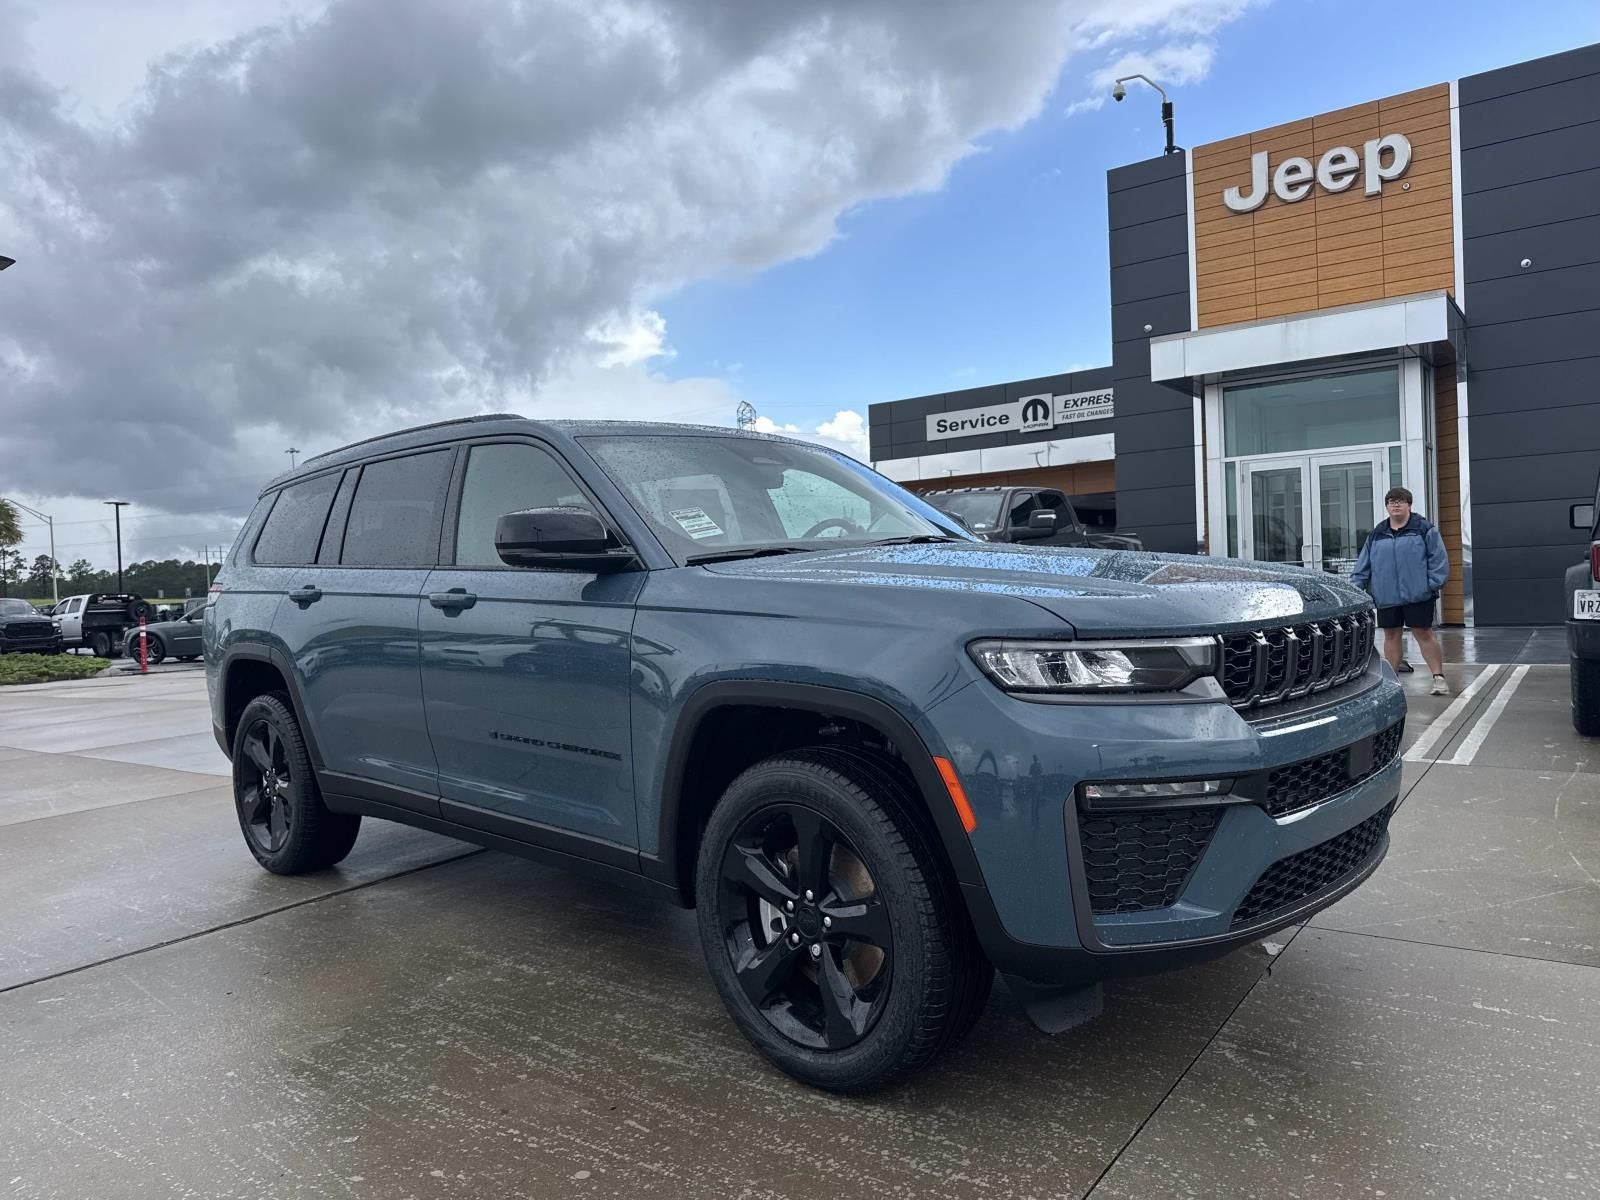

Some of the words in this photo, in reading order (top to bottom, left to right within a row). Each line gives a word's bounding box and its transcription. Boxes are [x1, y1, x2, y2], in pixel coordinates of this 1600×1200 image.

[1223, 133, 1412, 214] Jeep
[936, 413, 1010, 433] Service
[1062, 413, 1075, 421] FAST
